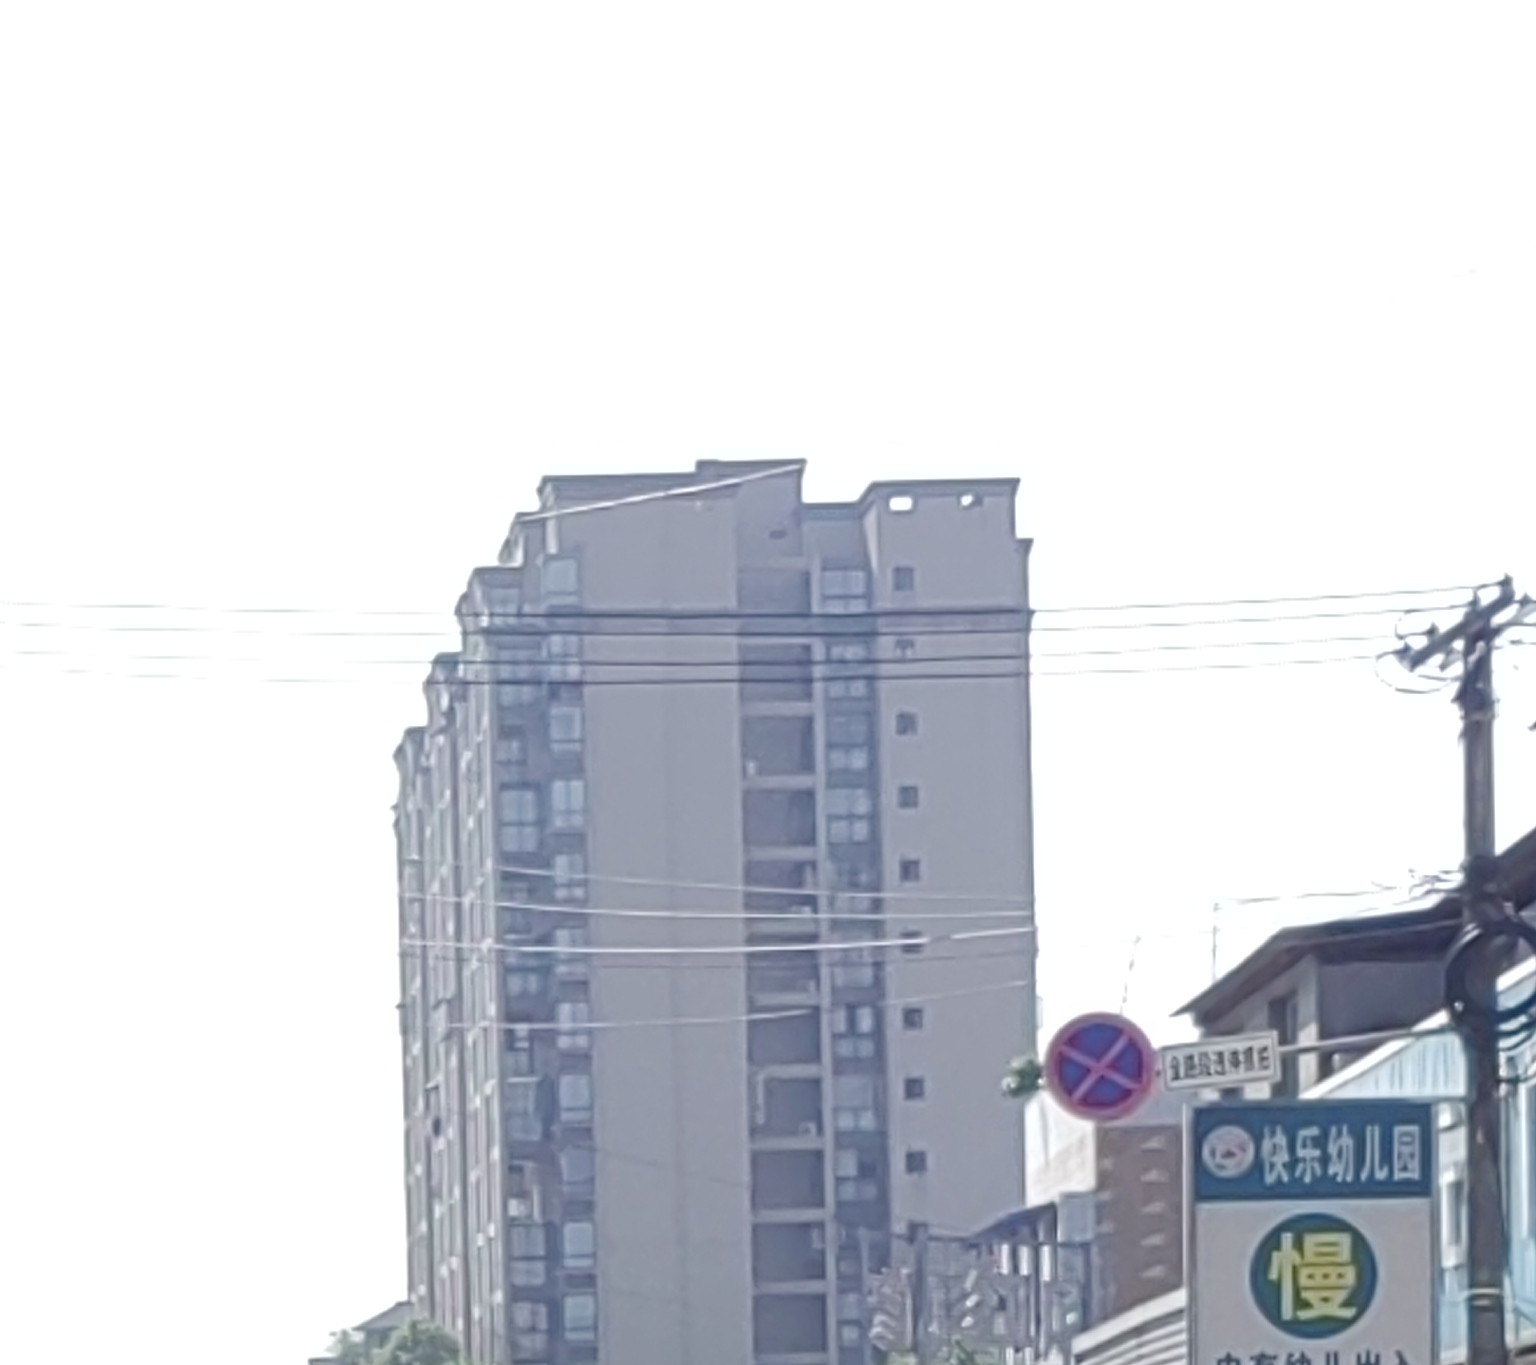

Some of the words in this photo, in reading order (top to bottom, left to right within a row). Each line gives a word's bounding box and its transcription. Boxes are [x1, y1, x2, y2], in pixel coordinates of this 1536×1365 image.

[1260, 1124, 1422, 1186] 快乐幼儿园
[1267, 1231, 1359, 1322] 慢
